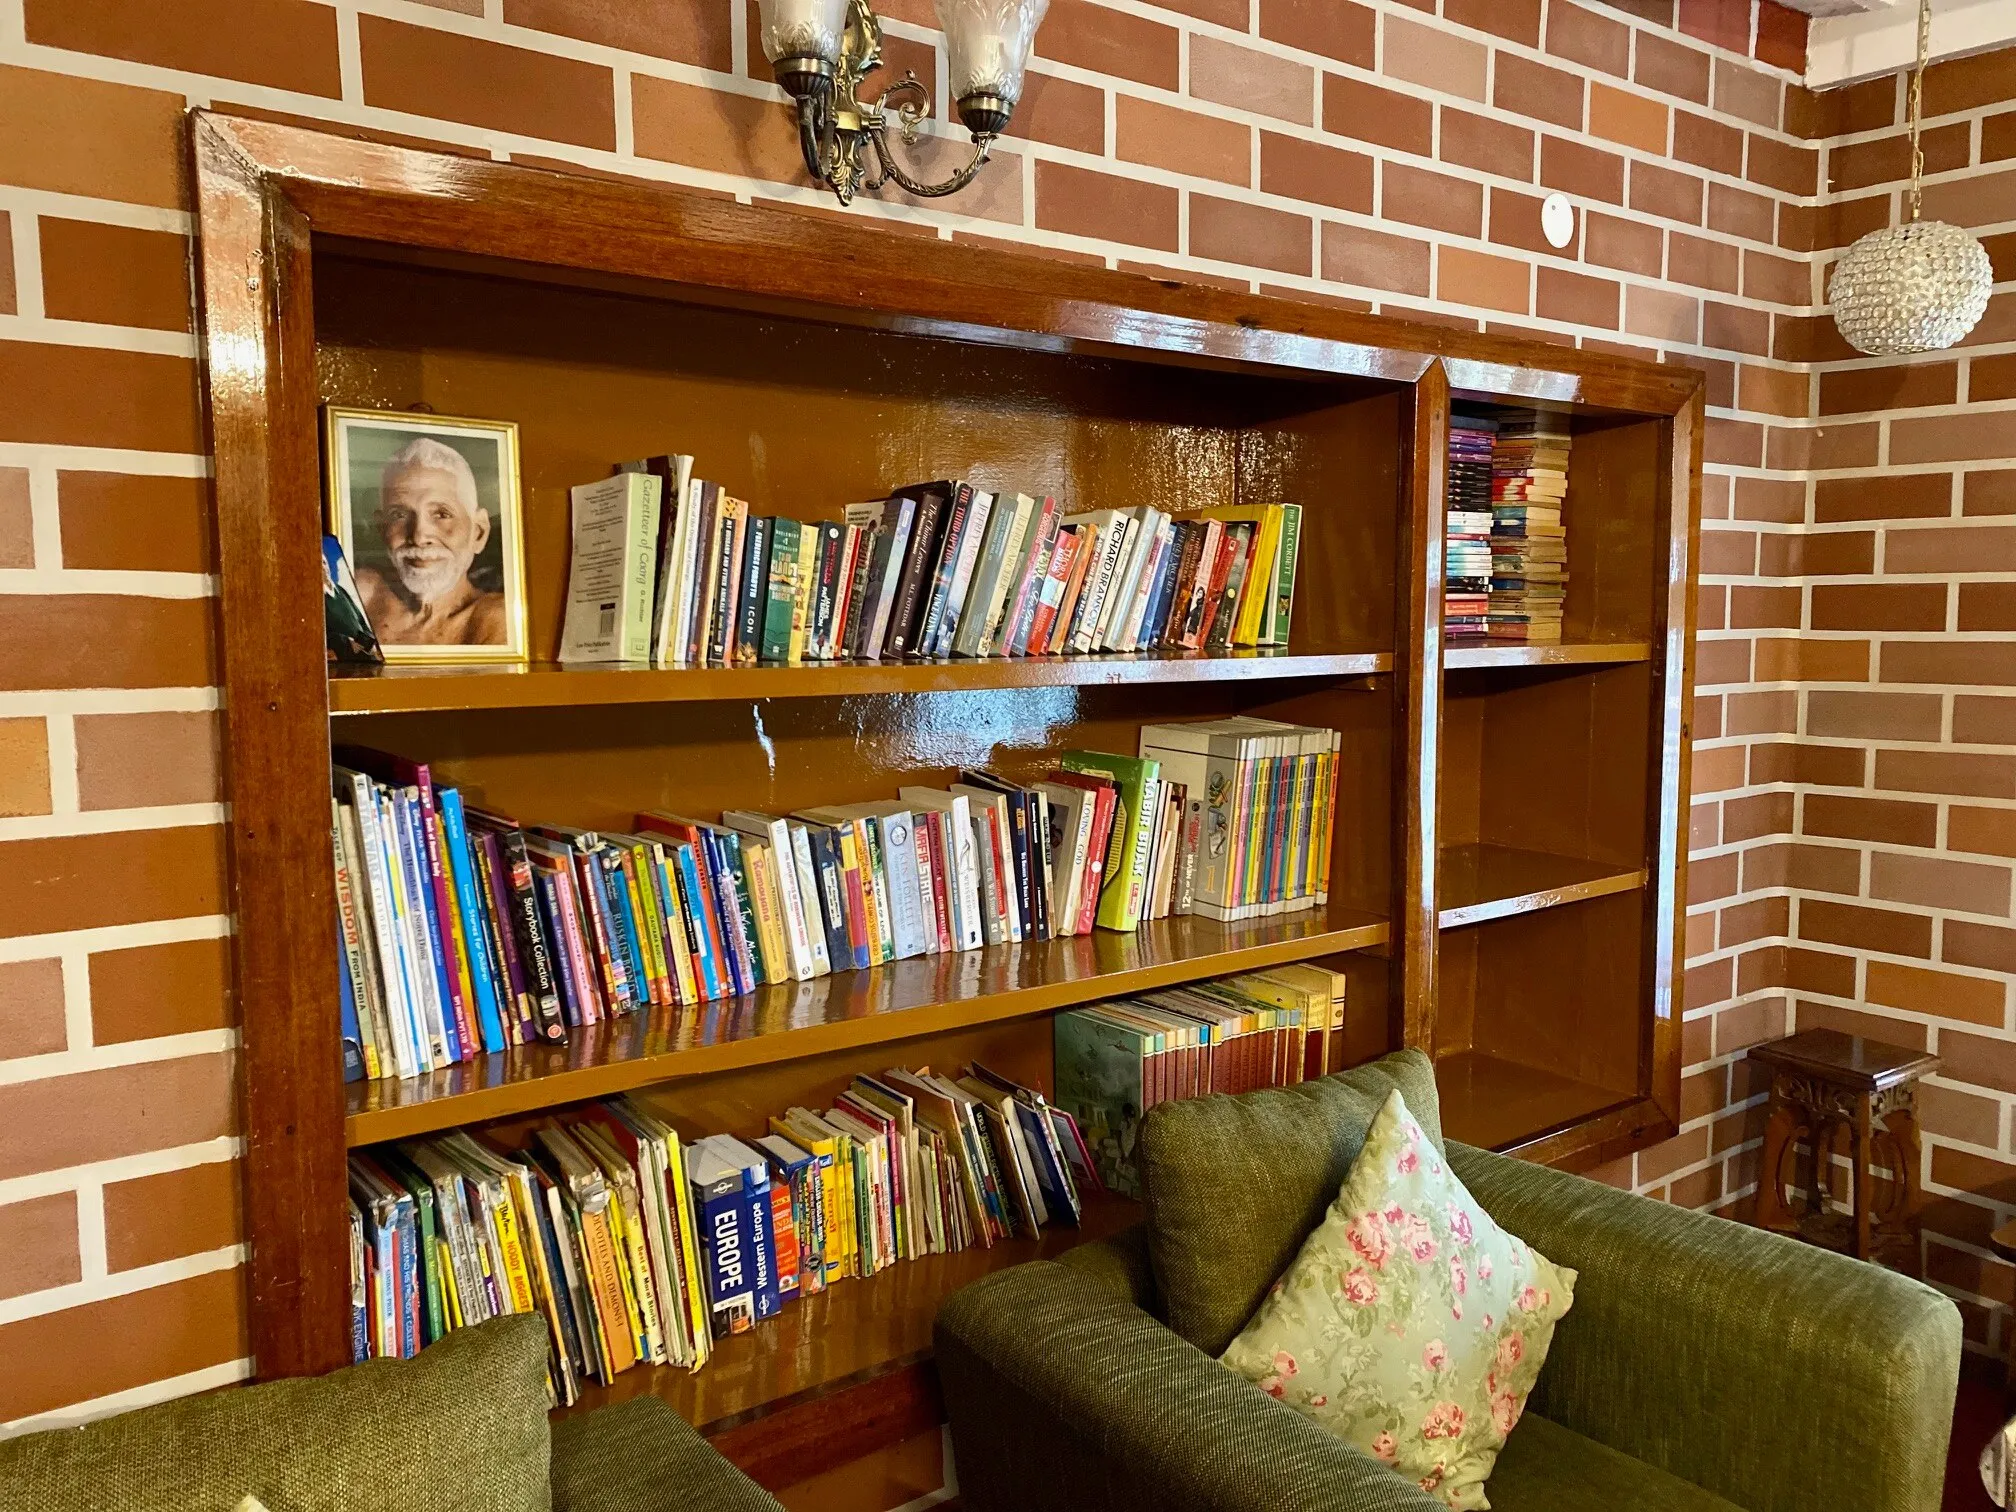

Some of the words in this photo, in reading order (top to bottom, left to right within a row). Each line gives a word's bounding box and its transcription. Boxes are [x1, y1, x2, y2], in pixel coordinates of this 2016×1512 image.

[641, 480, 653, 536] Gazetteer
[958, 488, 969, 503] THE
[726, 520, 732, 529] MY
[928, 504, 938, 518] The
[952, 507, 965, 532] THIRD
[972, 504, 988, 539] JEFFREY
[846, 527, 855, 550] RUGBY
[921, 520, 934, 547] Chinar
[1012, 515, 1028, 550] JEFFREY
[1035, 512, 1050, 544] GORGEOUS
[1187, 530, 1196, 545] THE
[1286, 521, 1296, 536] JIM
[638, 539, 654, 550] of
[724, 530, 732, 555] HUSBAND
[752, 531, 762, 565] FREDERICK
[944, 532, 958, 565] OPTION
[1103, 520, 1124, 571] RICHARD
[1172, 527, 1187, 561] JEFFREY
[1193, 537, 1201, 552] THE
[1284, 537, 1294, 576] CORBETT
[636, 553, 649, 585] Coorg
[914, 548, 928, 574] Leaves
[999, 550, 1018, 590] ARCHER
[1056, 546, 1073, 580] THORN
[1188, 552, 1198, 571] OATH
[721, 568, 729, 586] OTHER
[749, 566, 760, 598] FORSYTH
[908, 584, 916, 596] M.L.
[1165, 561, 1178, 594] ARCHER
[719, 587, 727, 612] ANIMALS
[817, 586, 828, 627] PATTERSON
[901, 597, 912, 627] FOTEDAR
[931, 593, 943, 612] VINCE
[1077, 599, 1086, 616] SELF
[1086, 572, 1110, 629] BRANSON
[747, 606, 755, 633] ICON
[926, 612, 938, 633] FLYNN
[1020, 606, 1035, 640] Better
[1140, 777, 1156, 826] KABIR
[930, 817, 938, 847] CHETAN
[1080, 803, 1092, 837] LOVING
[331, 827, 341, 851] TALES
[916, 826, 929, 864] MAFIA
[336, 852, 342, 862] OF
[693, 841, 703, 866] PLANET
[698, 868, 708, 890] EARTH
[900, 852, 909, 876] KEN
[1075, 844, 1084, 865] GOD
[1133, 831, 1149, 877] BIJAK
[1185, 854, 1194, 879] NEVER
[405, 858, 419, 904] Hunchback
[546, 883, 555, 900] ROALD
[752, 858, 771, 922] Ramayana
[919, 864, 931, 903] STATE
[1186, 880, 1190, 888] OF
[337, 868, 358, 945] WISDOM
[411, 904, 419, 912] of
[549, 902, 558, 917] DAHL
[793, 901, 802, 926] ROBINSON
[878, 909, 884, 919] OF
[904, 879, 914, 927] FOLLETT
[962, 874, 973, 927] WEISBERGER
[989, 897, 997, 919] STORIES
[414, 914, 424, 937] Notre
[468, 909, 479, 936] Stories
[649, 915, 658, 942] GAUTAMA
[718, 883, 726, 900] Magic
[727, 933, 735, 951] Fairies
[417, 938, 428, 961] Dame
[474, 938, 482, 950] for
[523, 897, 541, 944] Storybook
[533, 944, 550, 989] Collection
[797, 927, 806, 948] CRUSOE
[350, 950, 360, 979] FROM
[612, 912, 629, 955] RUSKIN
[623, 958, 635, 993] BOND
[746, 940, 758, 964] Magic
[475, 952, 489, 983] Children
[355, 982, 366, 1011] INDIA
[458, 1022, 466, 1032] PVT
[752, 1202, 764, 1242] Europe
[496, 1205, 511, 1237] Blyton
[506, 1240, 519, 1271] NODDY
[514, 1276, 530, 1310] BIGGEST
[592, 1215, 609, 1259] DEVOTEES
[601, 1261, 613, 1282] AND
[637, 1246, 646, 1263] Best
[714, 1209, 743, 1291] EUROPE
[640, 1263, 647, 1273] of
[756, 1243, 767, 1289] Western
[486, 1282, 498, 1316] Mysterious
[642, 1277, 651, 1299] Moral
[647, 1300, 657, 1328] Stories
[353, 1324, 364, 1361] ENGINE
